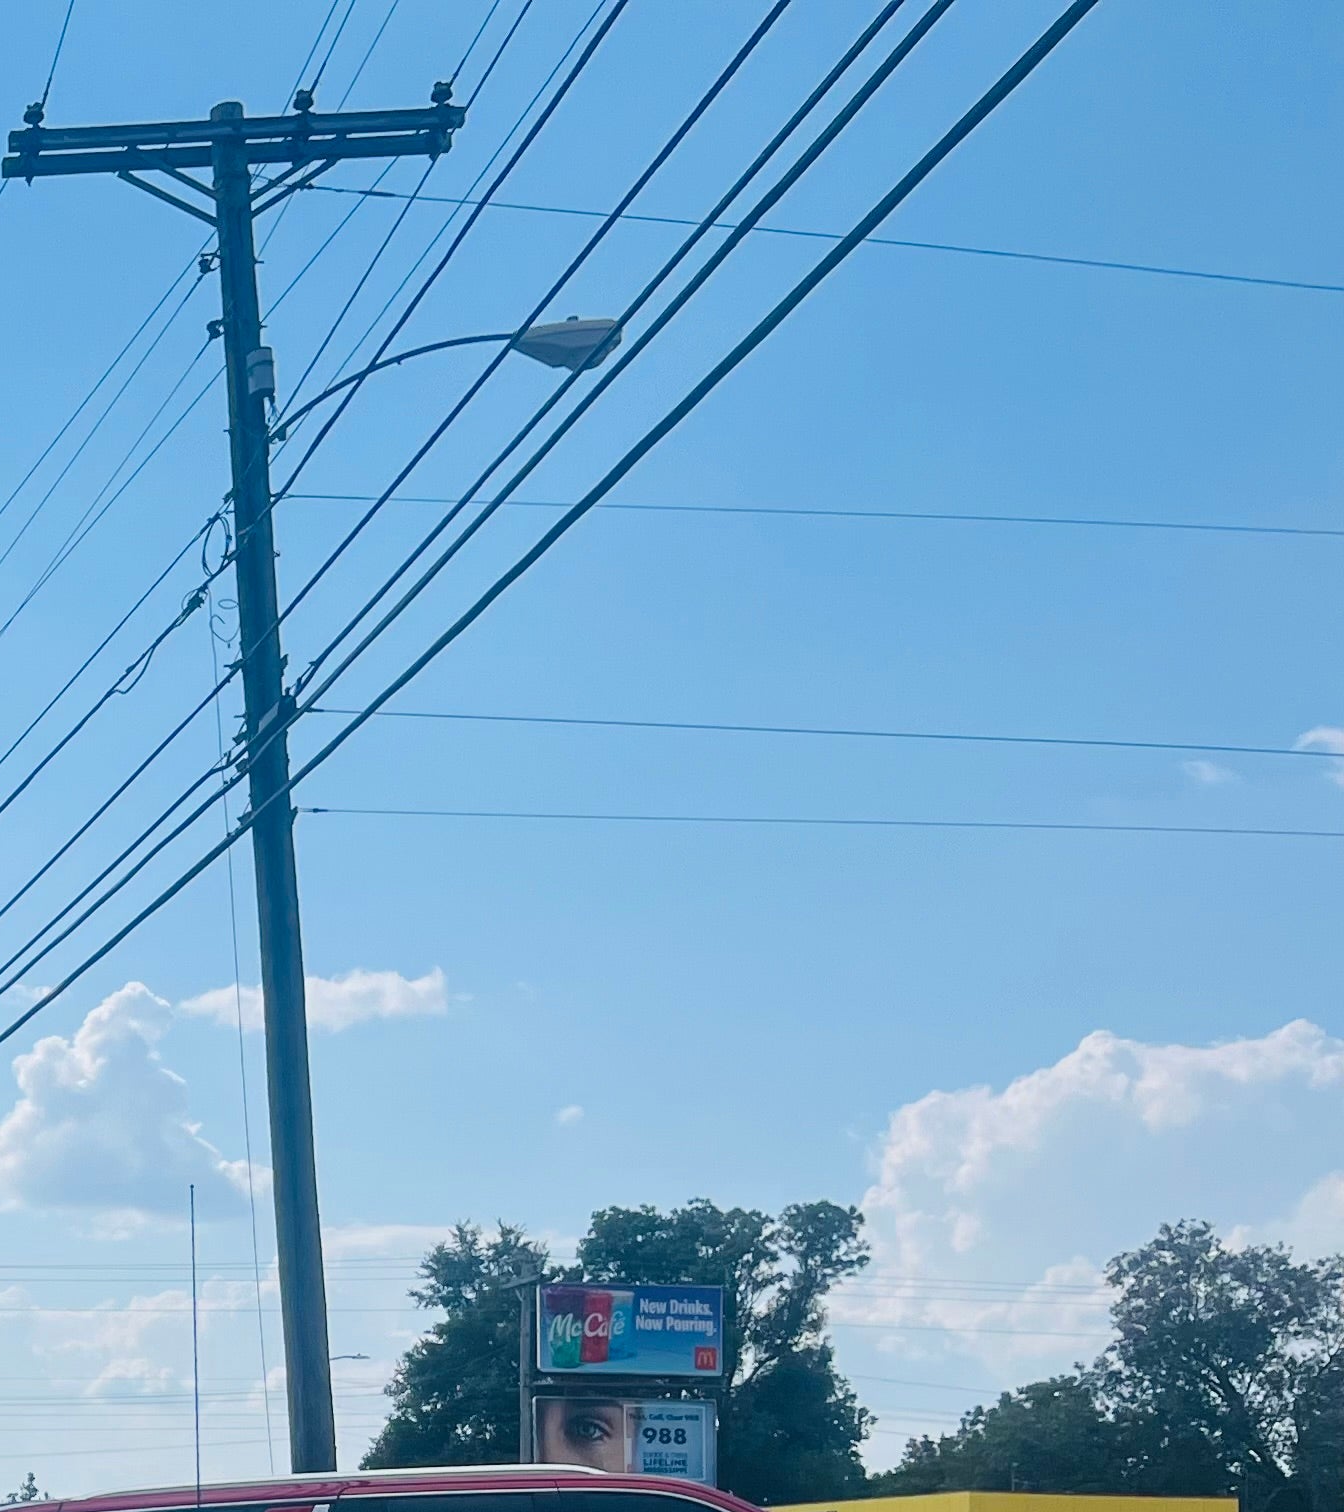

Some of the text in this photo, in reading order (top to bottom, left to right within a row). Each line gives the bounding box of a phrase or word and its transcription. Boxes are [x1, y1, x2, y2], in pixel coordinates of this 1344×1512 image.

[640, 1298, 714, 1316] New Drinks.
[636, 1315, 718, 1337] Now Pouring.
[642, 1427, 687, 1445] 988
